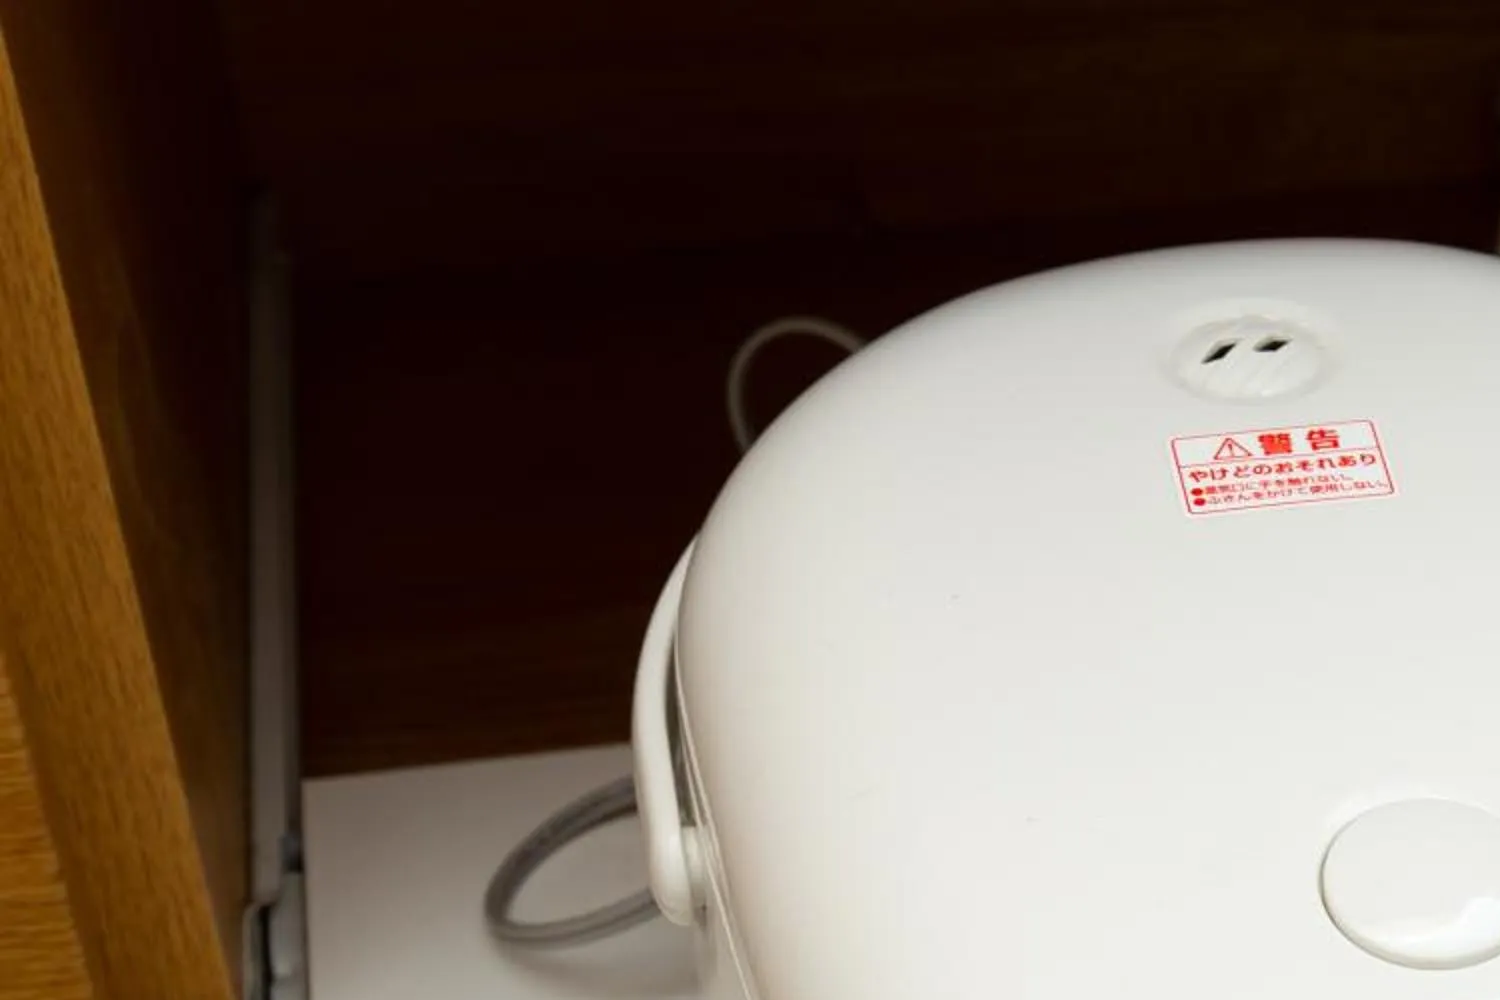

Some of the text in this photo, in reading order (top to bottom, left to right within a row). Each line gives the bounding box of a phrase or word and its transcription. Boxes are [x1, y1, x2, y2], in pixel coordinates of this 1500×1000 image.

[1257, 428, 1341, 456] 警告
[1188, 453, 1377, 483] やけどのおそれあり
